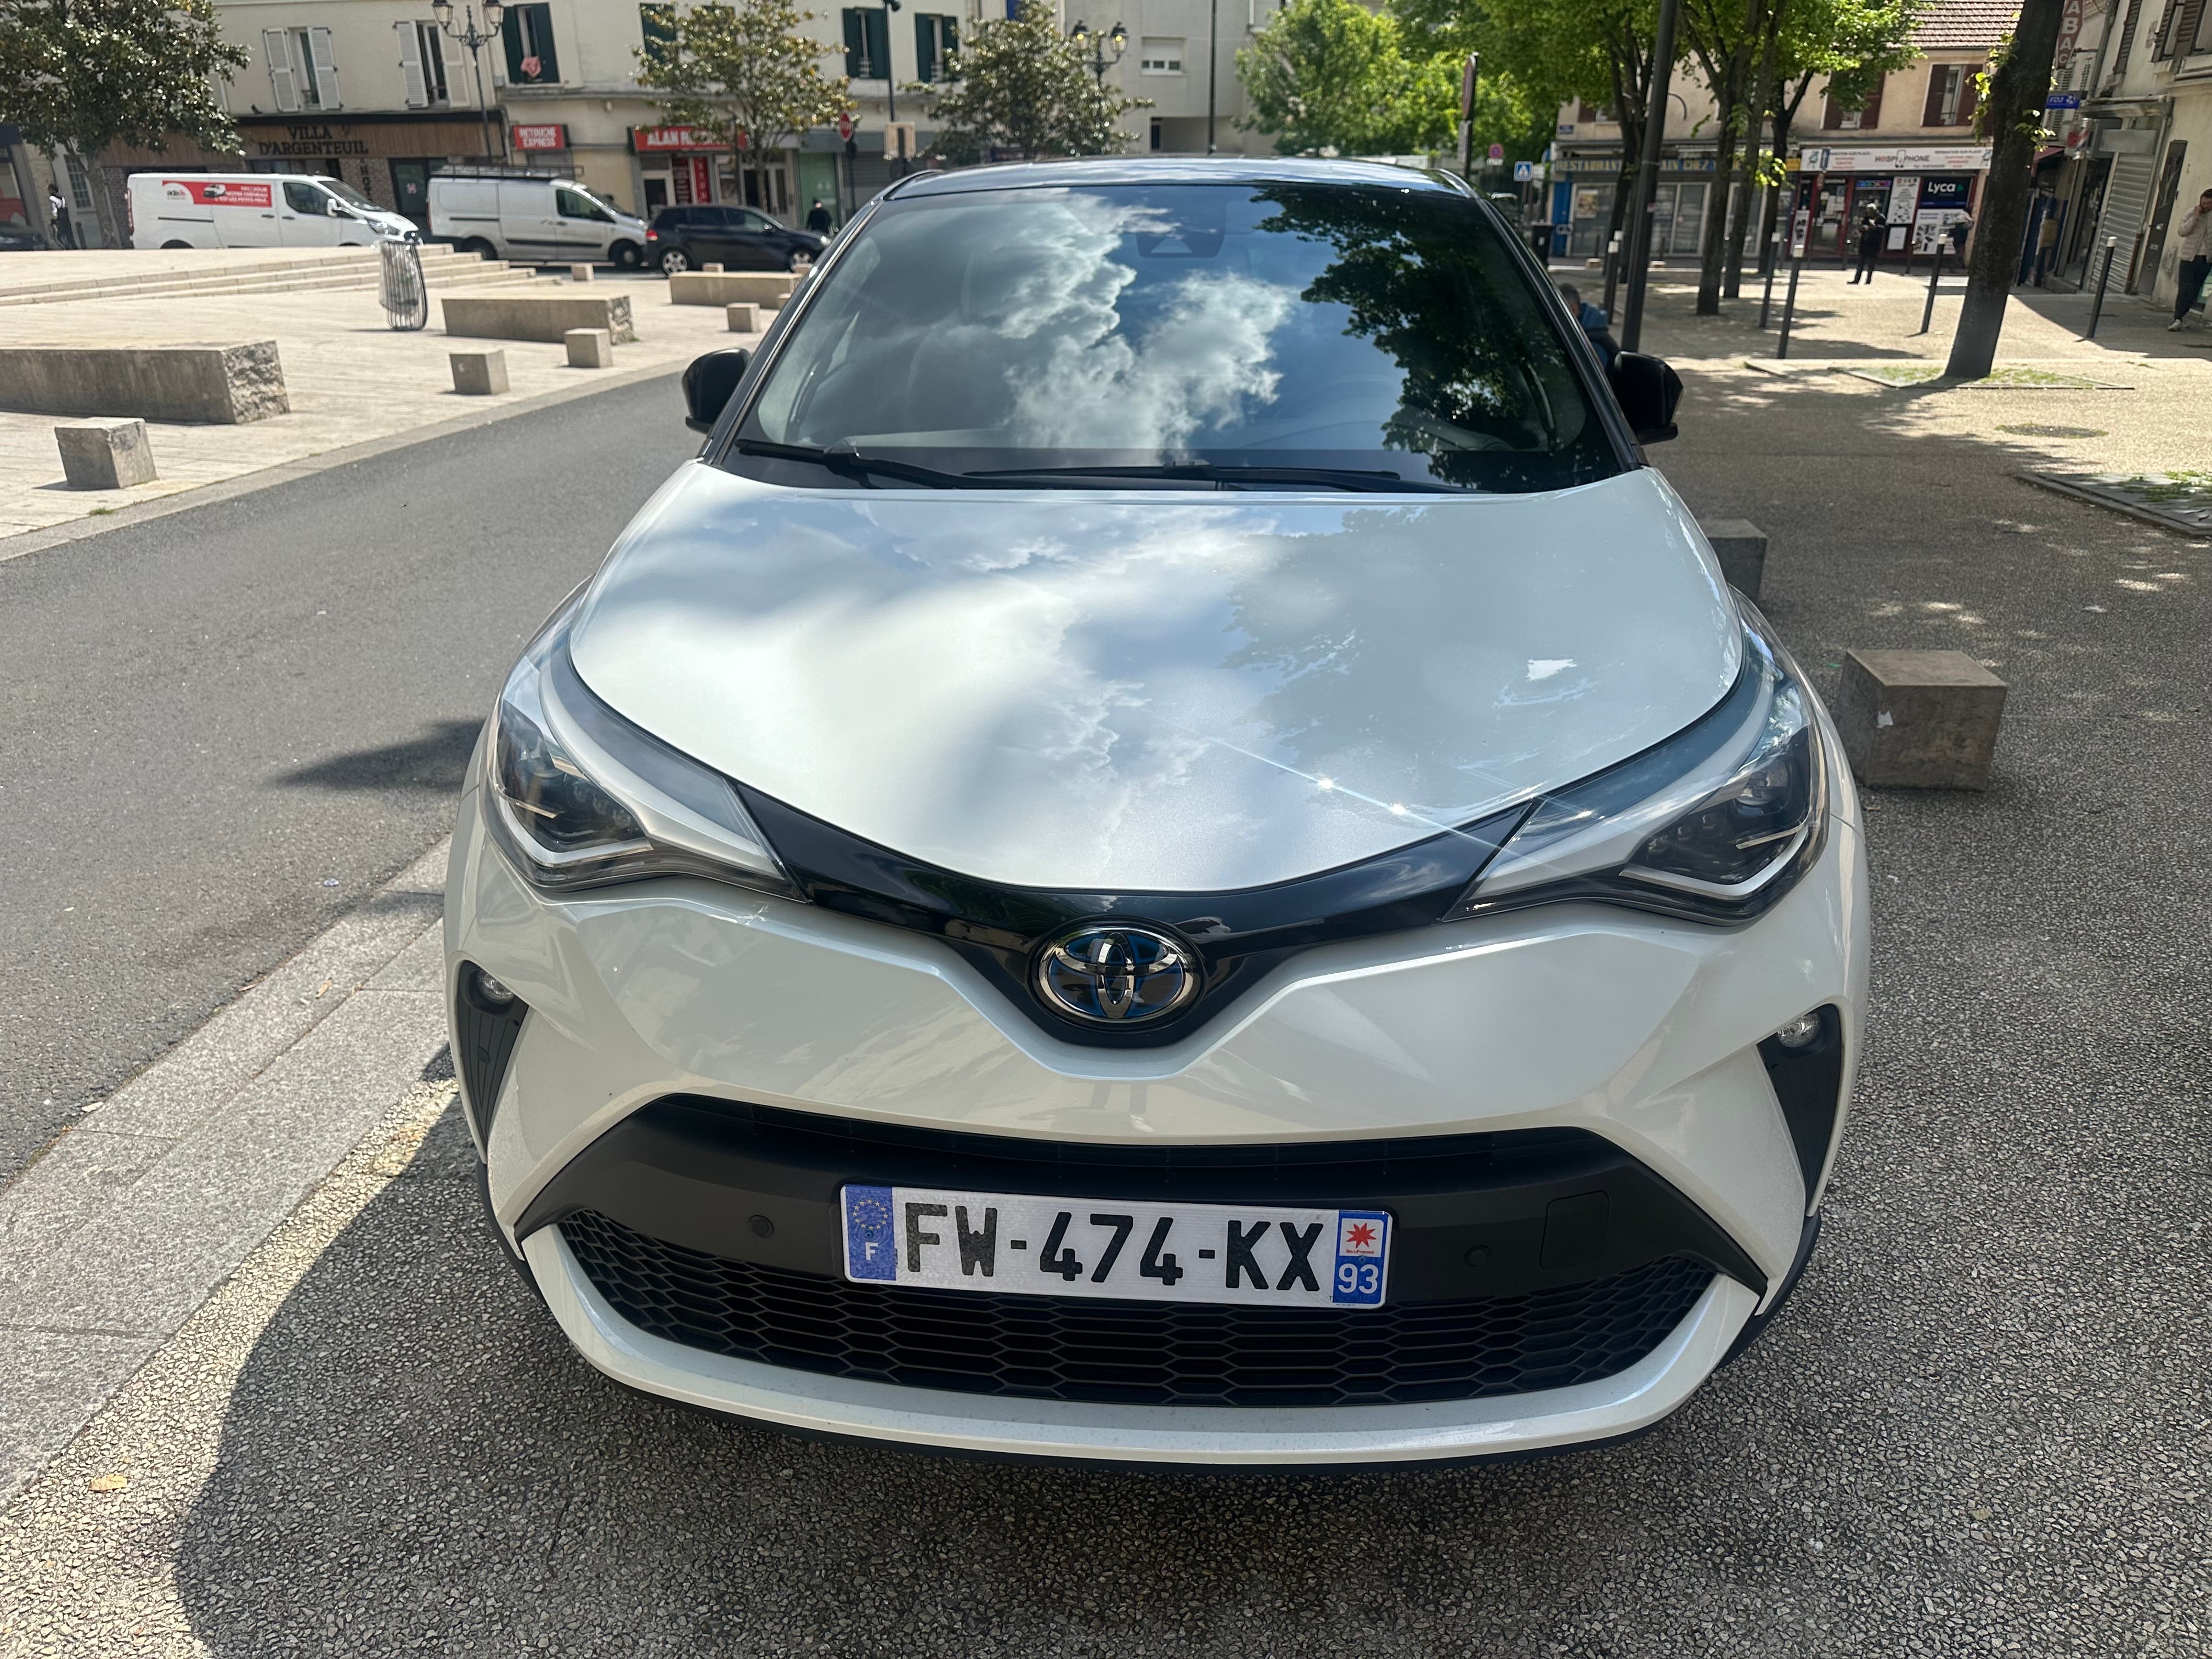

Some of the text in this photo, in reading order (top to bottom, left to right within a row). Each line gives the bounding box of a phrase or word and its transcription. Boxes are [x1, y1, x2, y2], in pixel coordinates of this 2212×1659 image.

[2058, 0, 2081, 64] ABAC
[288, 125, 332, 139] VILLA
[519, 126, 556, 137] RETOUCHE
[646, 129, 679, 146] ALAN
[258, 140, 369, 155] D'ARGENTEUIL
[523, 138, 556, 148] EXPRESS
[1556, 159, 1622, 172] RESTAURAN
[1927, 181, 1956, 194] Lyca
[865, 1242, 878, 1260] F
[905, 1201, 1324, 1291] FW-474-KX
[1338, 1263, 1379, 1294] 93
